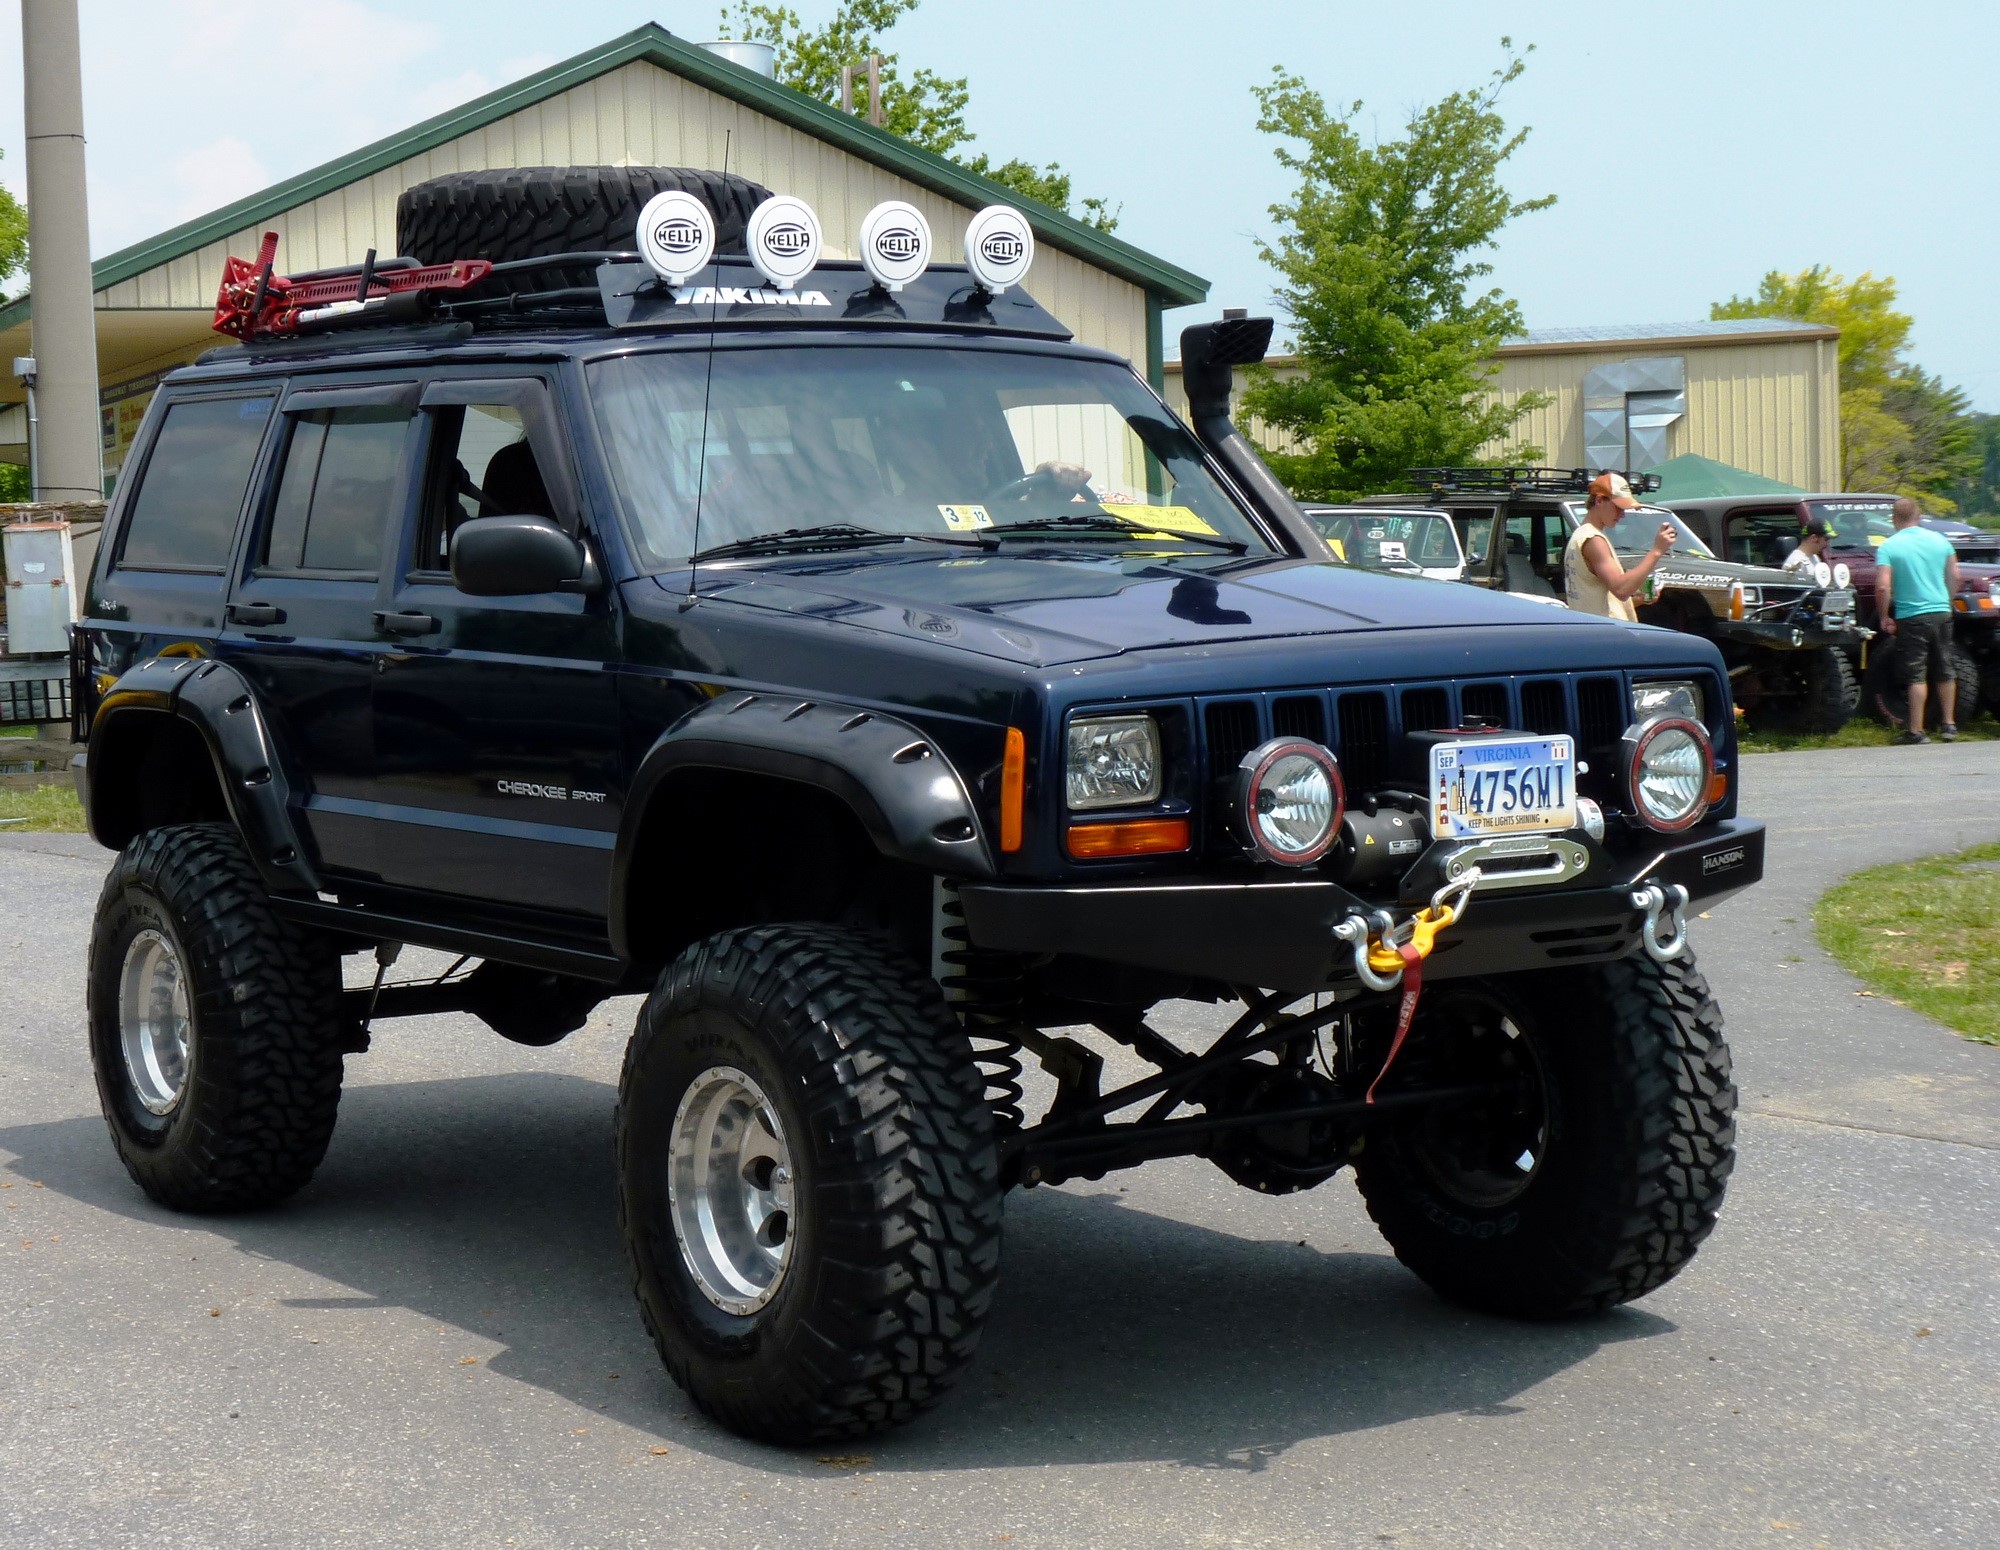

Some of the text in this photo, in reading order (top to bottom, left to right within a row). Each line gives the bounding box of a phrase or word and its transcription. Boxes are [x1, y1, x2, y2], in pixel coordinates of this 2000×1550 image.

[658, 228, 702, 244] HELLA
[767, 232, 810, 248] HELLA
[880, 237, 920, 253] HELLA
[984, 242, 1023, 257] HELLA
[666, 286, 832, 306] YAKIMA
[945, 507, 987, 522] 3 12
[1687, 574, 1734, 582] COUNTRY
[1475, 746, 1531, 762] VIRGINIA
[1554, 748, 1564, 758] 11
[1440, 756, 1454, 768] SEP
[497, 780, 606, 802] CHEROKEE SPORT
[1468, 764, 1565, 813] 4756MI
[1468, 813, 1540, 829] KEEP THE LIGHTS SHINING
[1703, 850, 1744, 869] HANSON
[1399, 991, 1416, 1028] WARN
